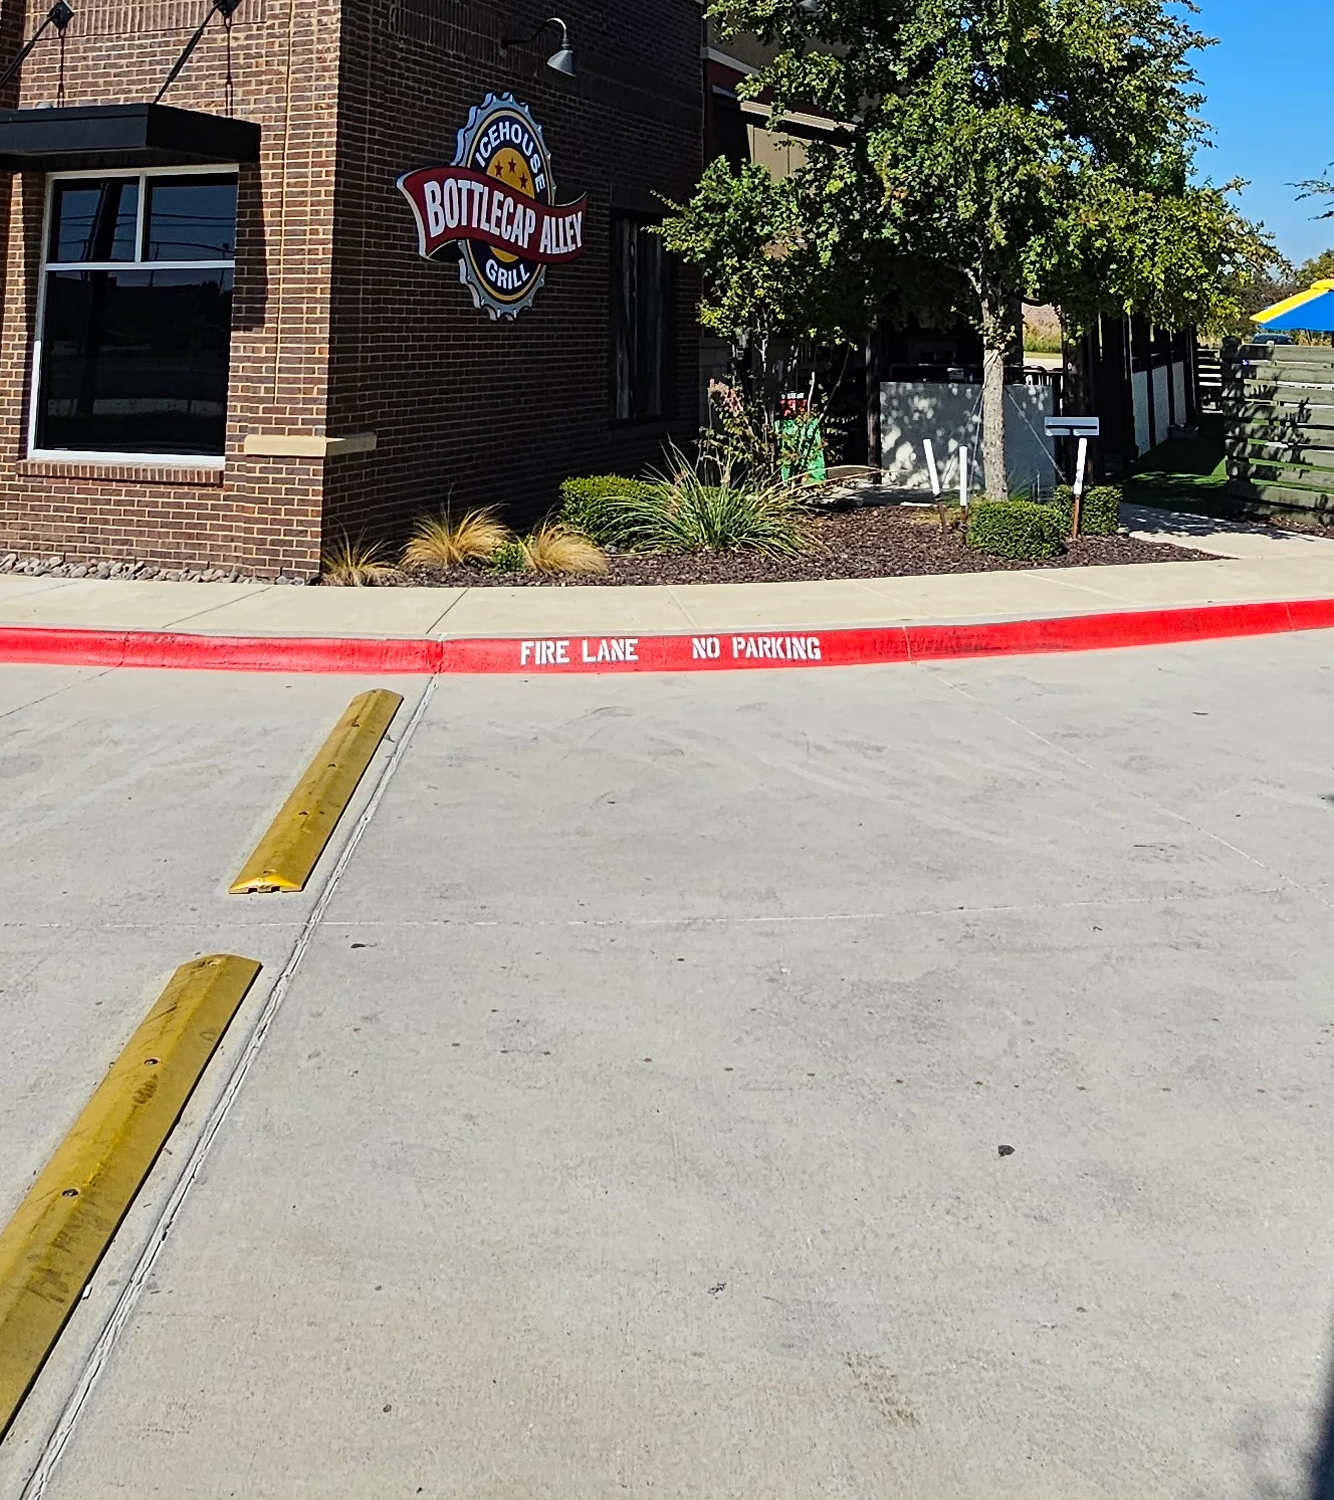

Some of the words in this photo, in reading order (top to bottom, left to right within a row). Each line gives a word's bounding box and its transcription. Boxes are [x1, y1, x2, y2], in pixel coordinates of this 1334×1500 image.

[475, 121, 546, 193] ICEHOUSE
[423, 178, 536, 249] BOTTLECAP
[539, 210, 583, 254] ALLEY
[485, 258, 530, 290] GRILL
[520, 640, 571, 666] FIRE
[582, 638, 639, 663] LANE
[692, 636, 721, 659] NO
[732, 636, 822, 660] PARKING
